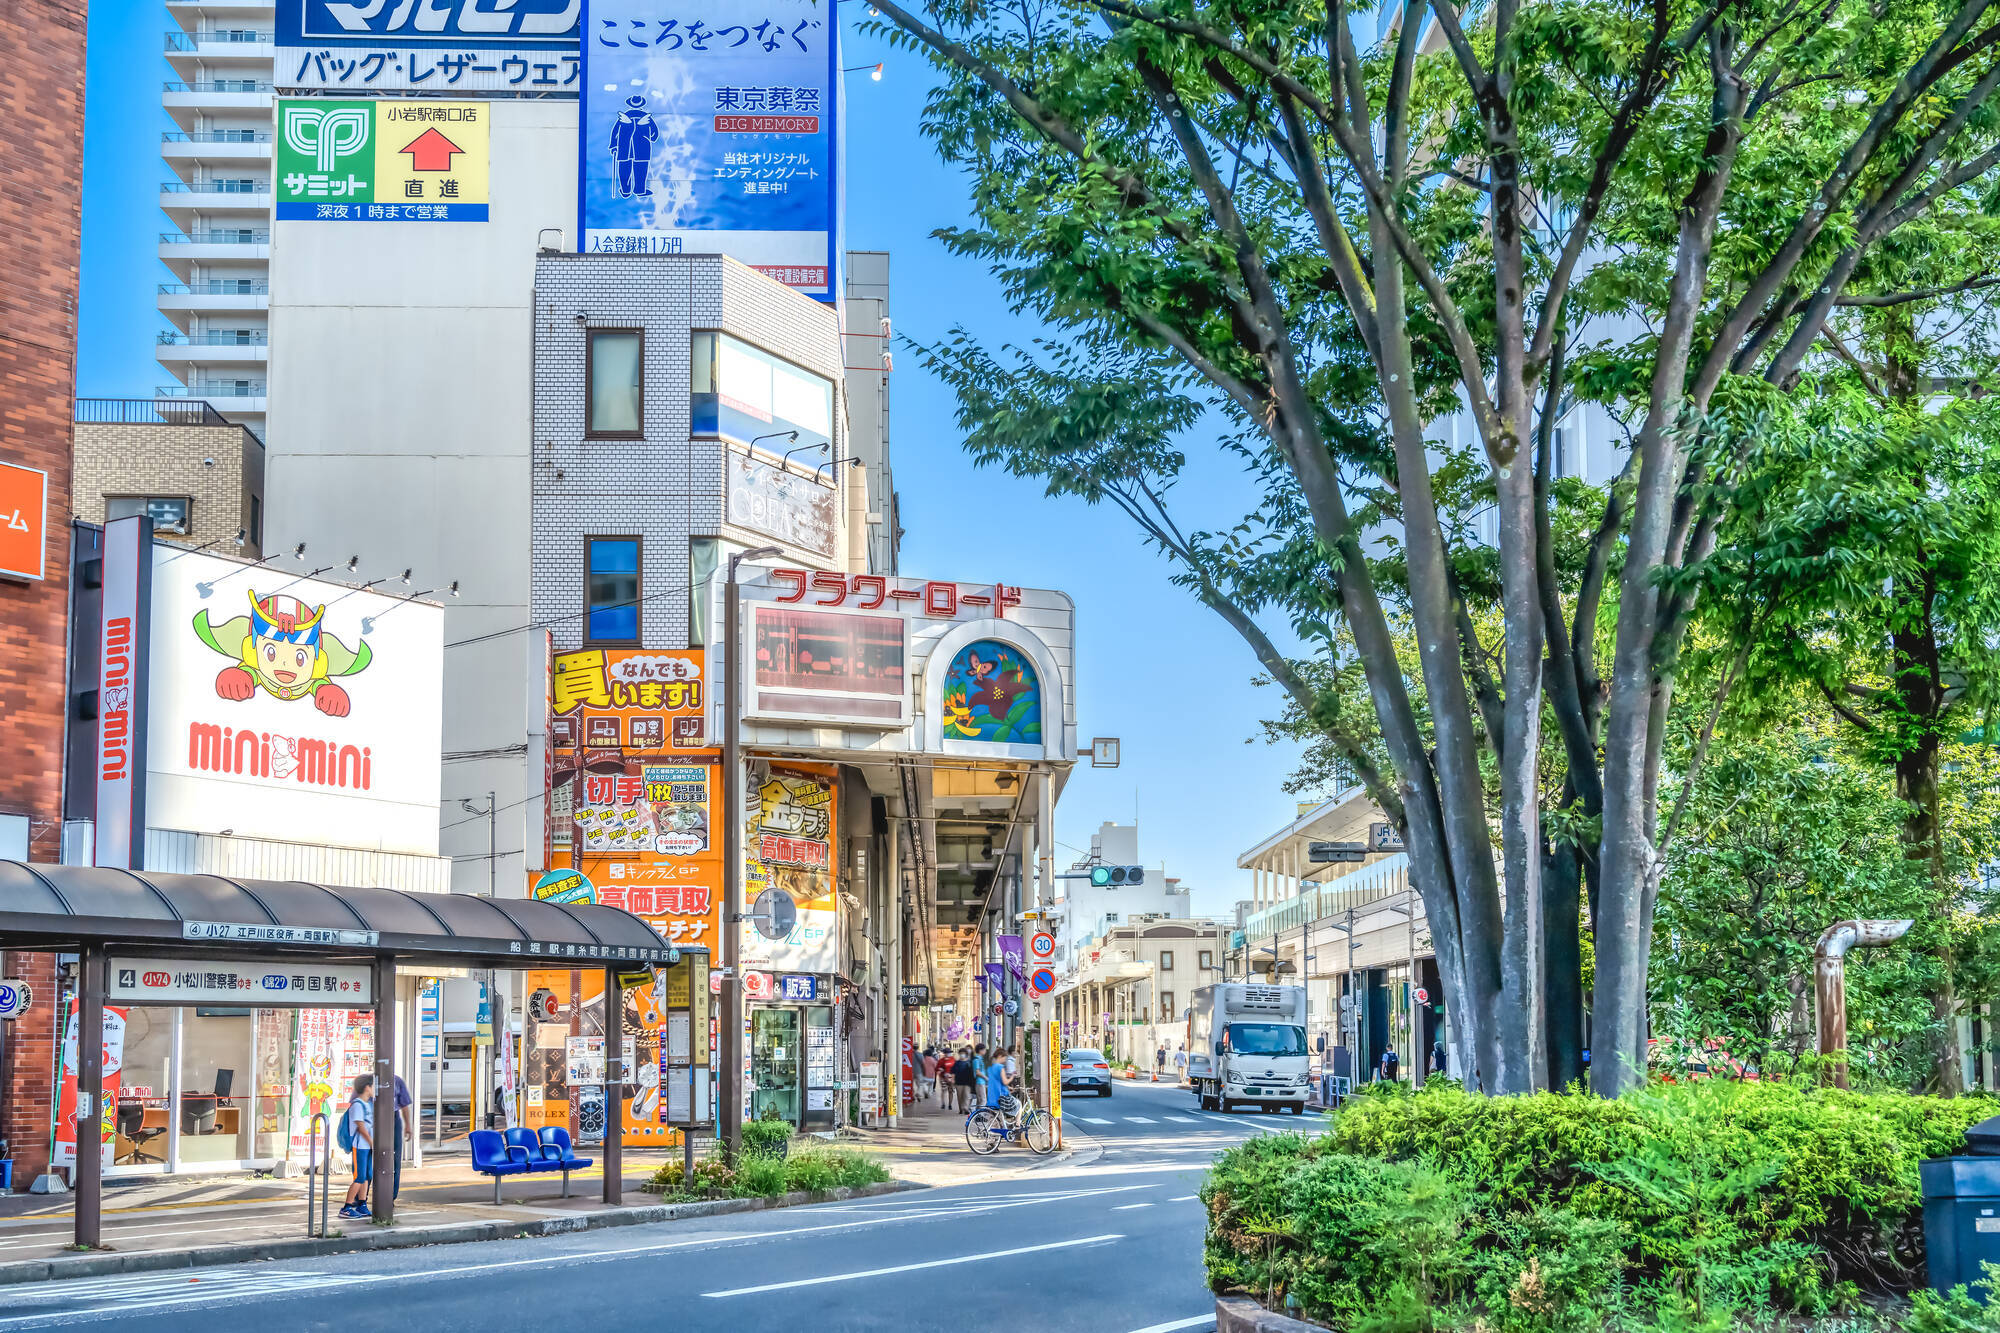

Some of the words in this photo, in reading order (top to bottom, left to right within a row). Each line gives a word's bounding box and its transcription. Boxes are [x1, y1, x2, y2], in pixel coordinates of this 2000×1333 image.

[599, 18, 821, 52] こころをつなぐ
[297, 51, 580, 84] バッグ・レザーウェア
[715, 86, 820, 111] 東京葬祭
[388, 107, 476, 122] 小岩駅南口店
[719, 118, 748, 131] BIG
[752, 118, 815, 131] MEMORY
[723, 152, 810, 165] 当社オリジナル
[714, 167, 819, 179] エンディングノート
[283, 173, 367, 196] サミット
[404, 179, 459, 198] 直進
[744, 181, 788, 194] 進呈中!
[316, 204, 449, 219] 深夜1時まで営業
[592, 236, 682, 254] 入会登録料1万円
[772, 569, 1021, 618] フラワーロード
[622, 663, 688, 677] なんでも
[613, 683, 701, 707] います!
[587, 775, 643, 805] 切手
[646, 784, 671, 801] 1枚
[761, 834, 825, 866] 高価買取!
[536, 874, 583, 900] 無料査定!
[598, 886, 710, 915] 高価買取
[206, 925, 230, 938] 小27
[645, 920, 709, 939] ラチナ
[804, 929, 824, 938] GP
[1036, 939, 1051, 951] 30
[120, 970, 135, 988] 4
[774, 983, 781, 994] &
[786, 978, 812, 998] 販売
[529, 1110, 566, 1119] ROLEX
